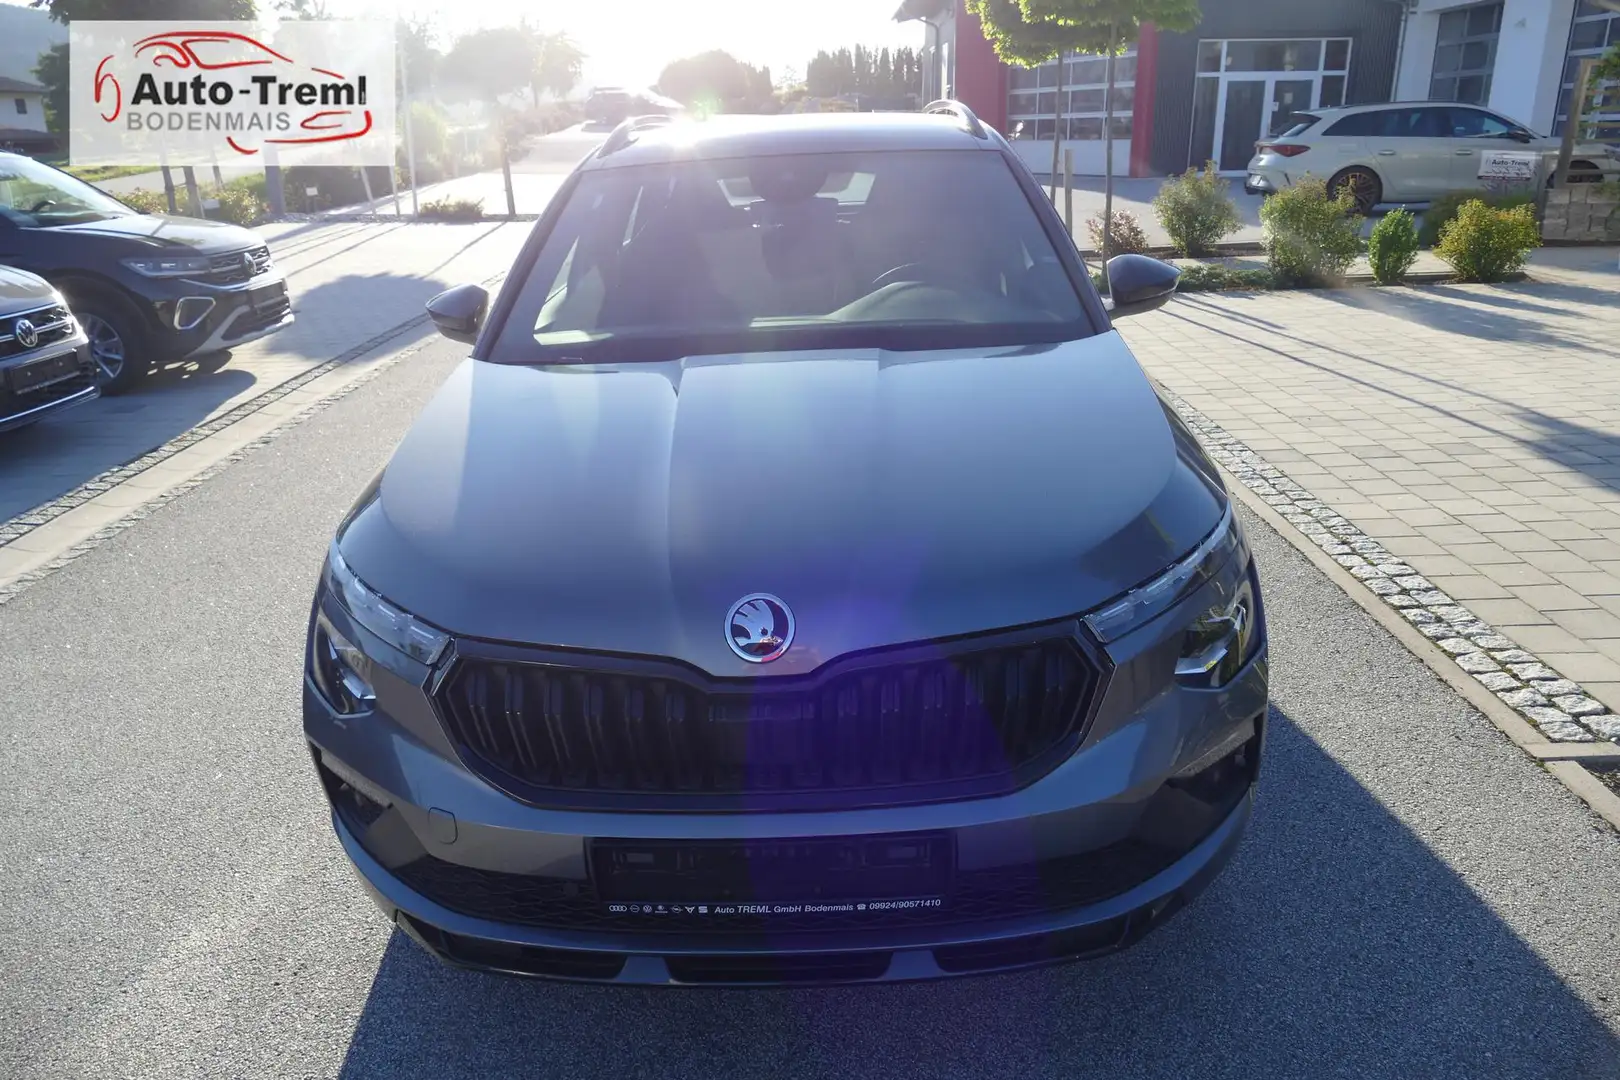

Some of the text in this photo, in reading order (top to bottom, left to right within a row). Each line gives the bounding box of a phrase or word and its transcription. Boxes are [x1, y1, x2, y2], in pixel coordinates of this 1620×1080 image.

[714, 899, 941, 914] Auto TREML GmbH Bodenmais 09924/90571410
